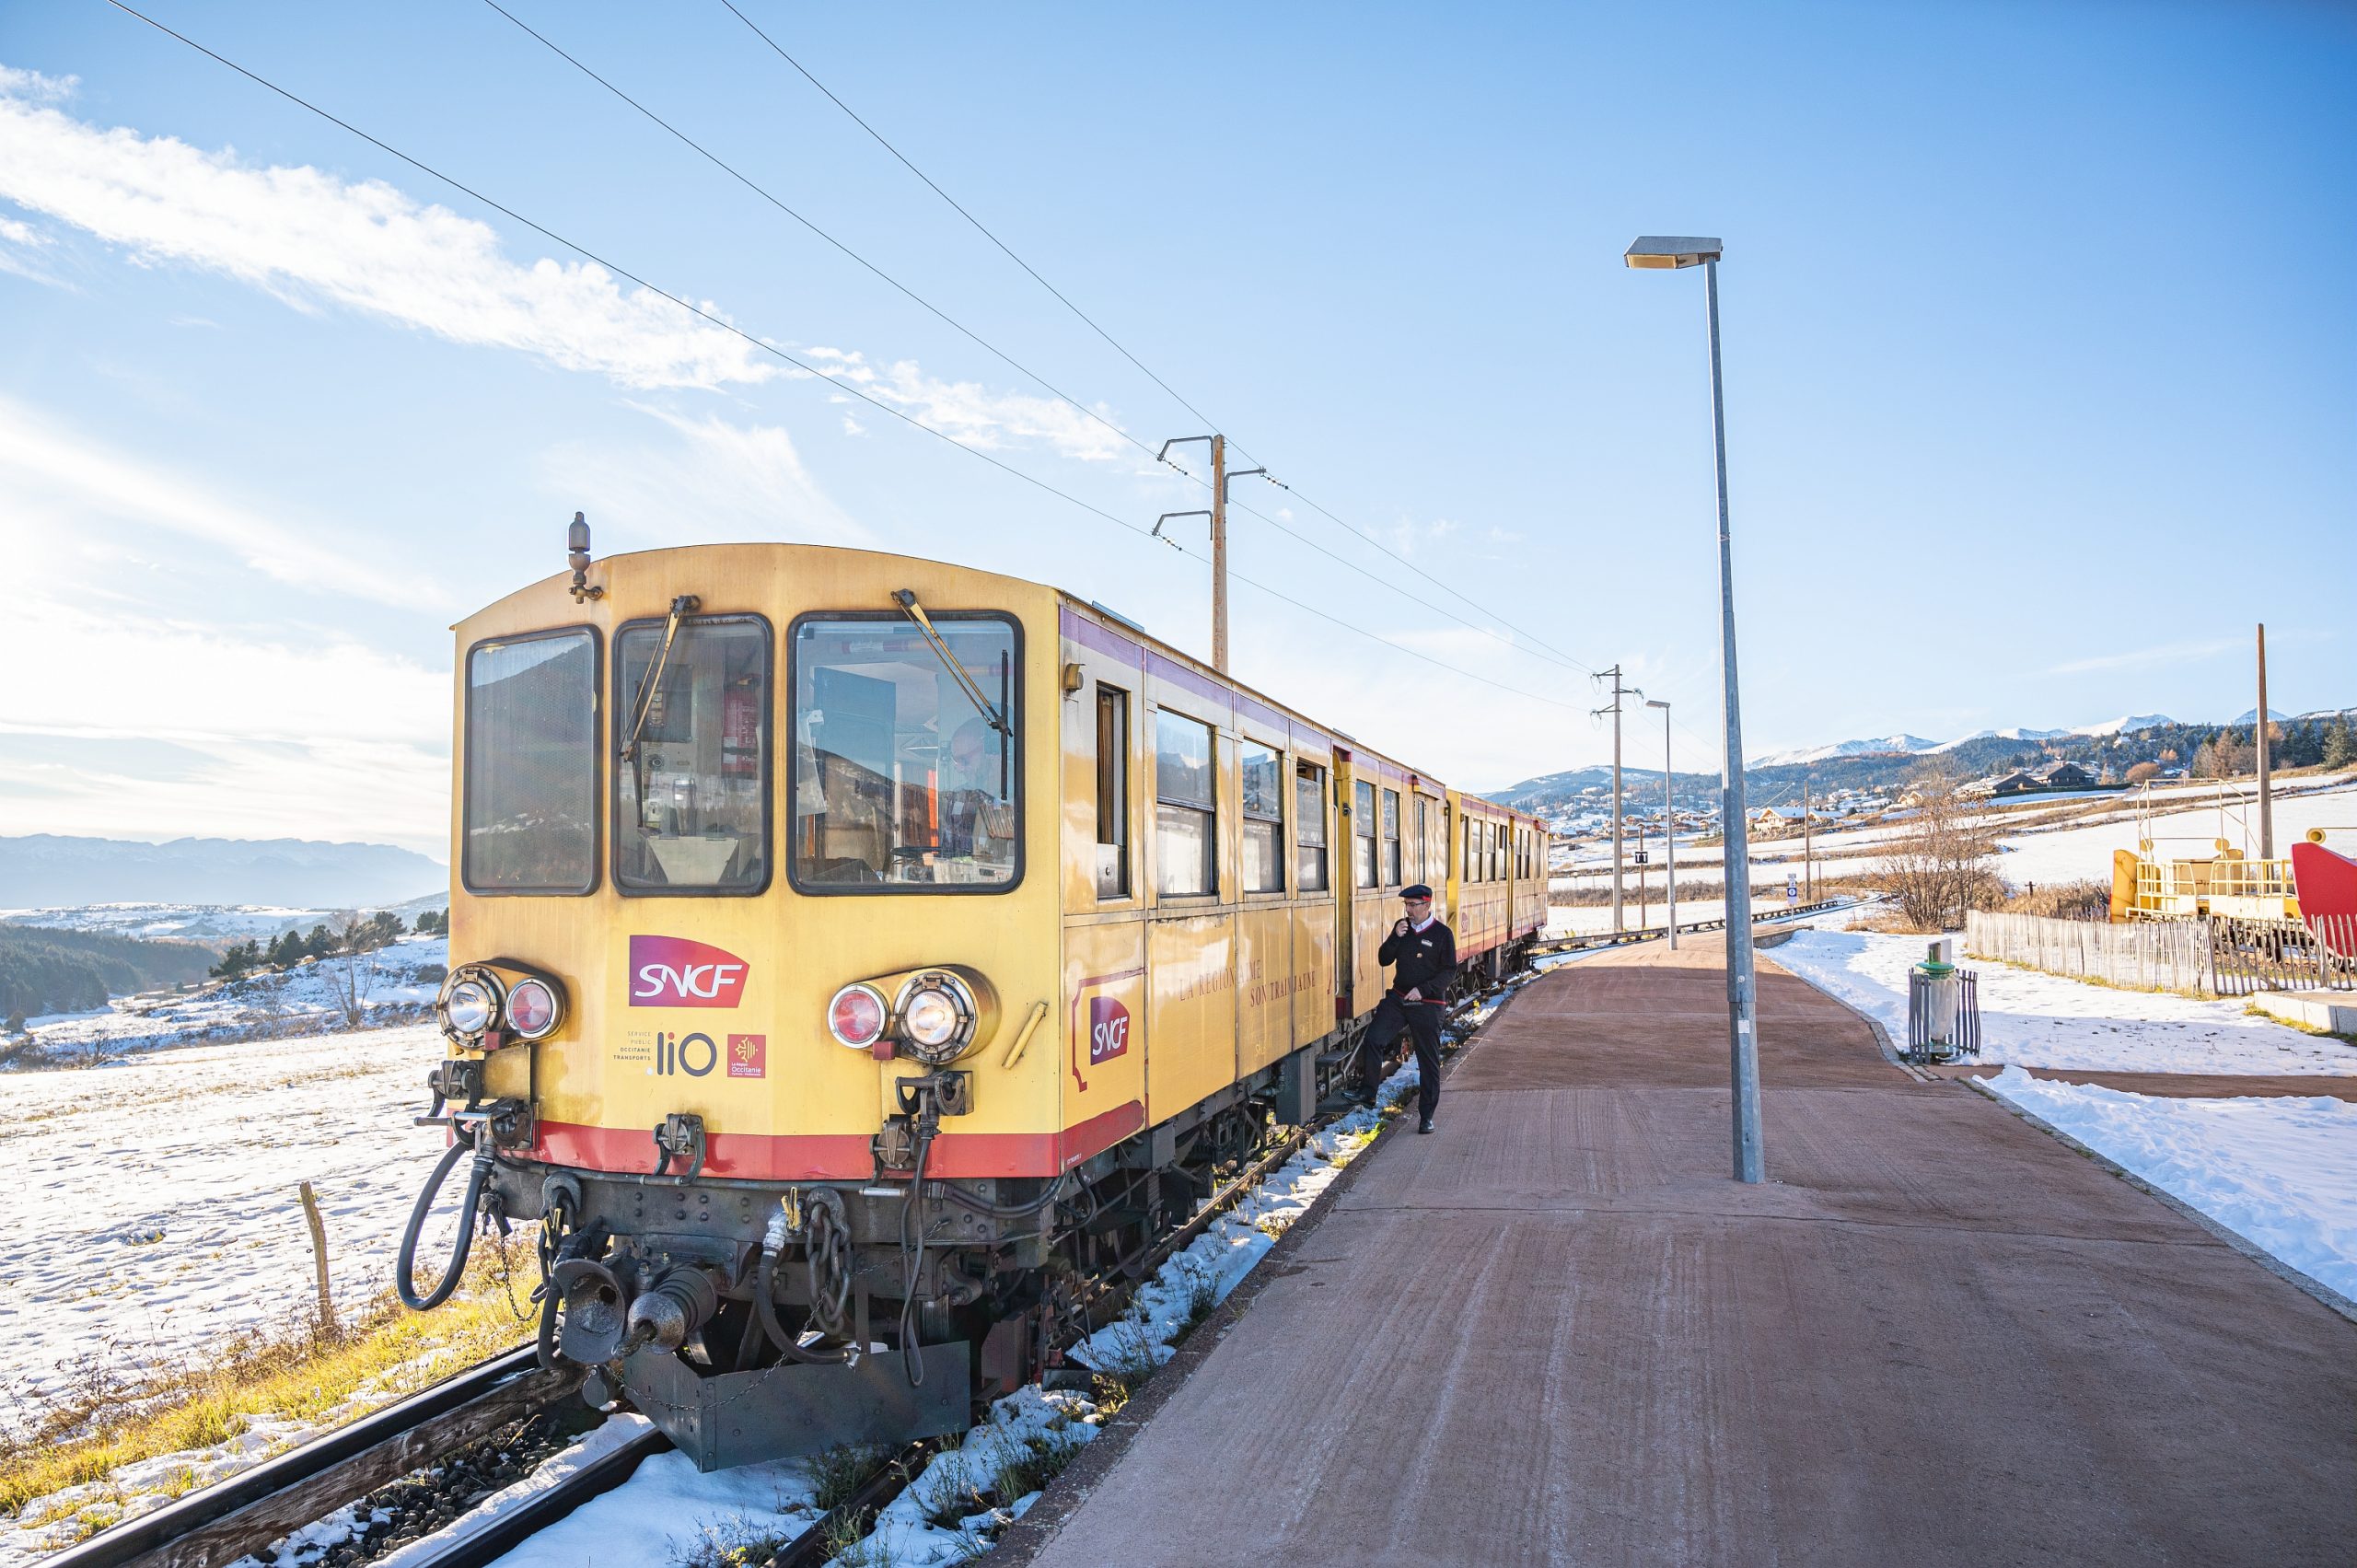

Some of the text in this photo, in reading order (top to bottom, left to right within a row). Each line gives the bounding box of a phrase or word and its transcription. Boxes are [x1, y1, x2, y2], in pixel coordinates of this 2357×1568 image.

[634, 963, 743, 998] SNCF
[1179, 979, 1194, 1002] LA
[1237, 959, 1261, 984] AIME
[1250, 970, 1316, 1008] SON TRAIN JAUNE
[1092, 1016, 1128, 1056] SNCF
